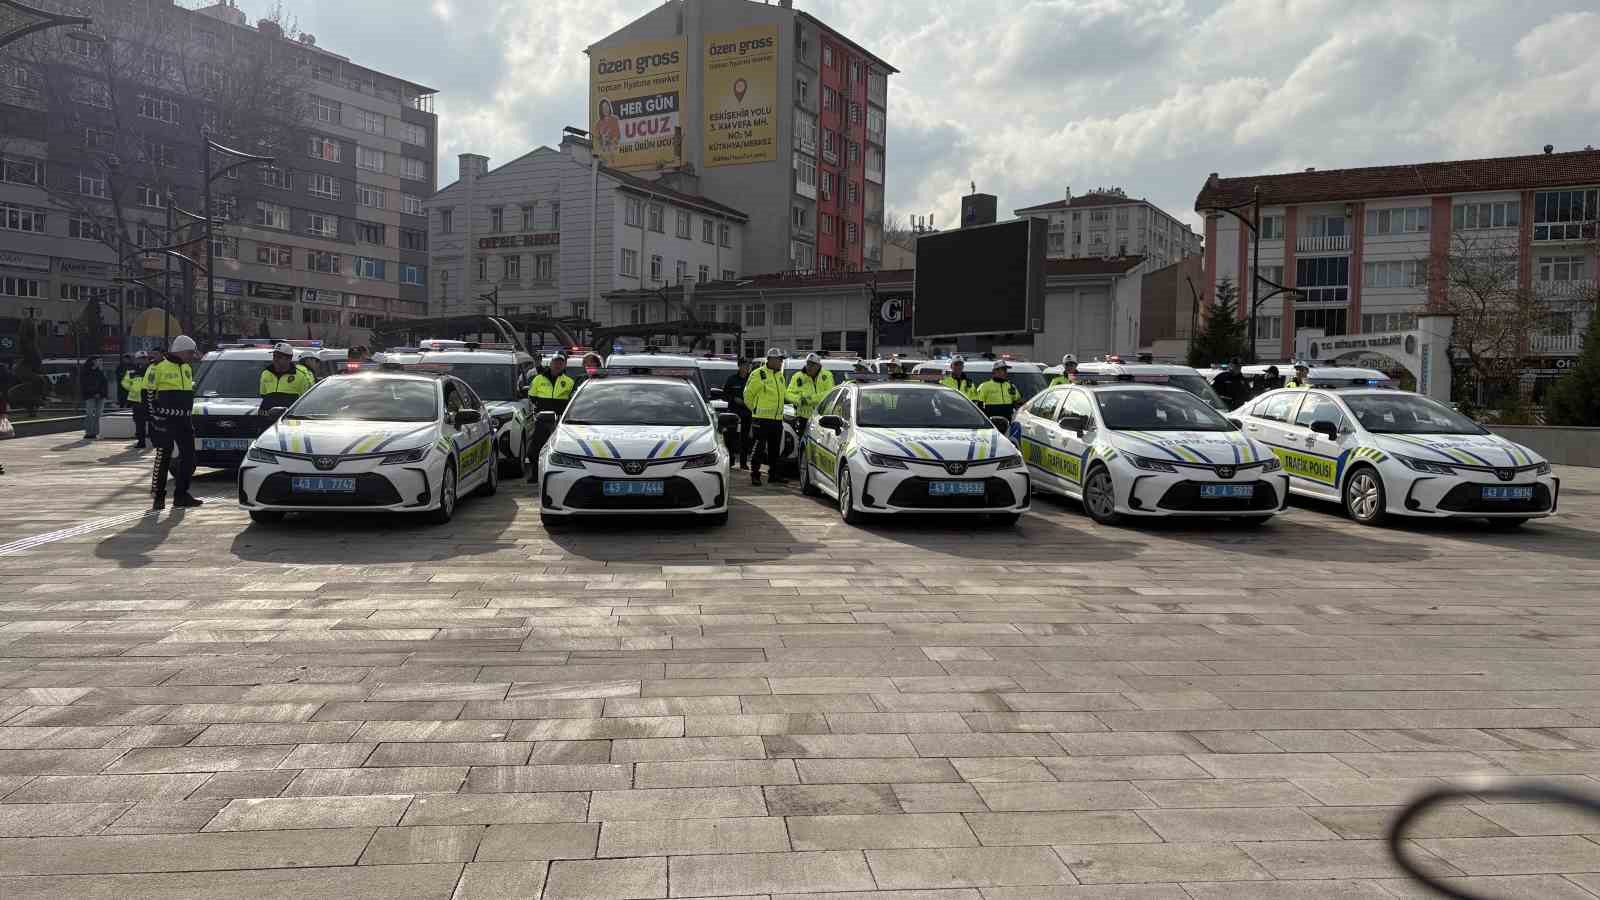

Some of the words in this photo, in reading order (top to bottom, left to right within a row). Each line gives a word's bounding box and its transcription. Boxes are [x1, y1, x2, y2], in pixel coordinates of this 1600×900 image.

[739, 37, 772, 55] gross
[598, 58, 632, 75] özen
[636, 51, 680, 74] gross
[620, 101, 641, 116] HER
[646, 95, 674, 112] GÜN
[625, 117, 671, 138] UCUZ
